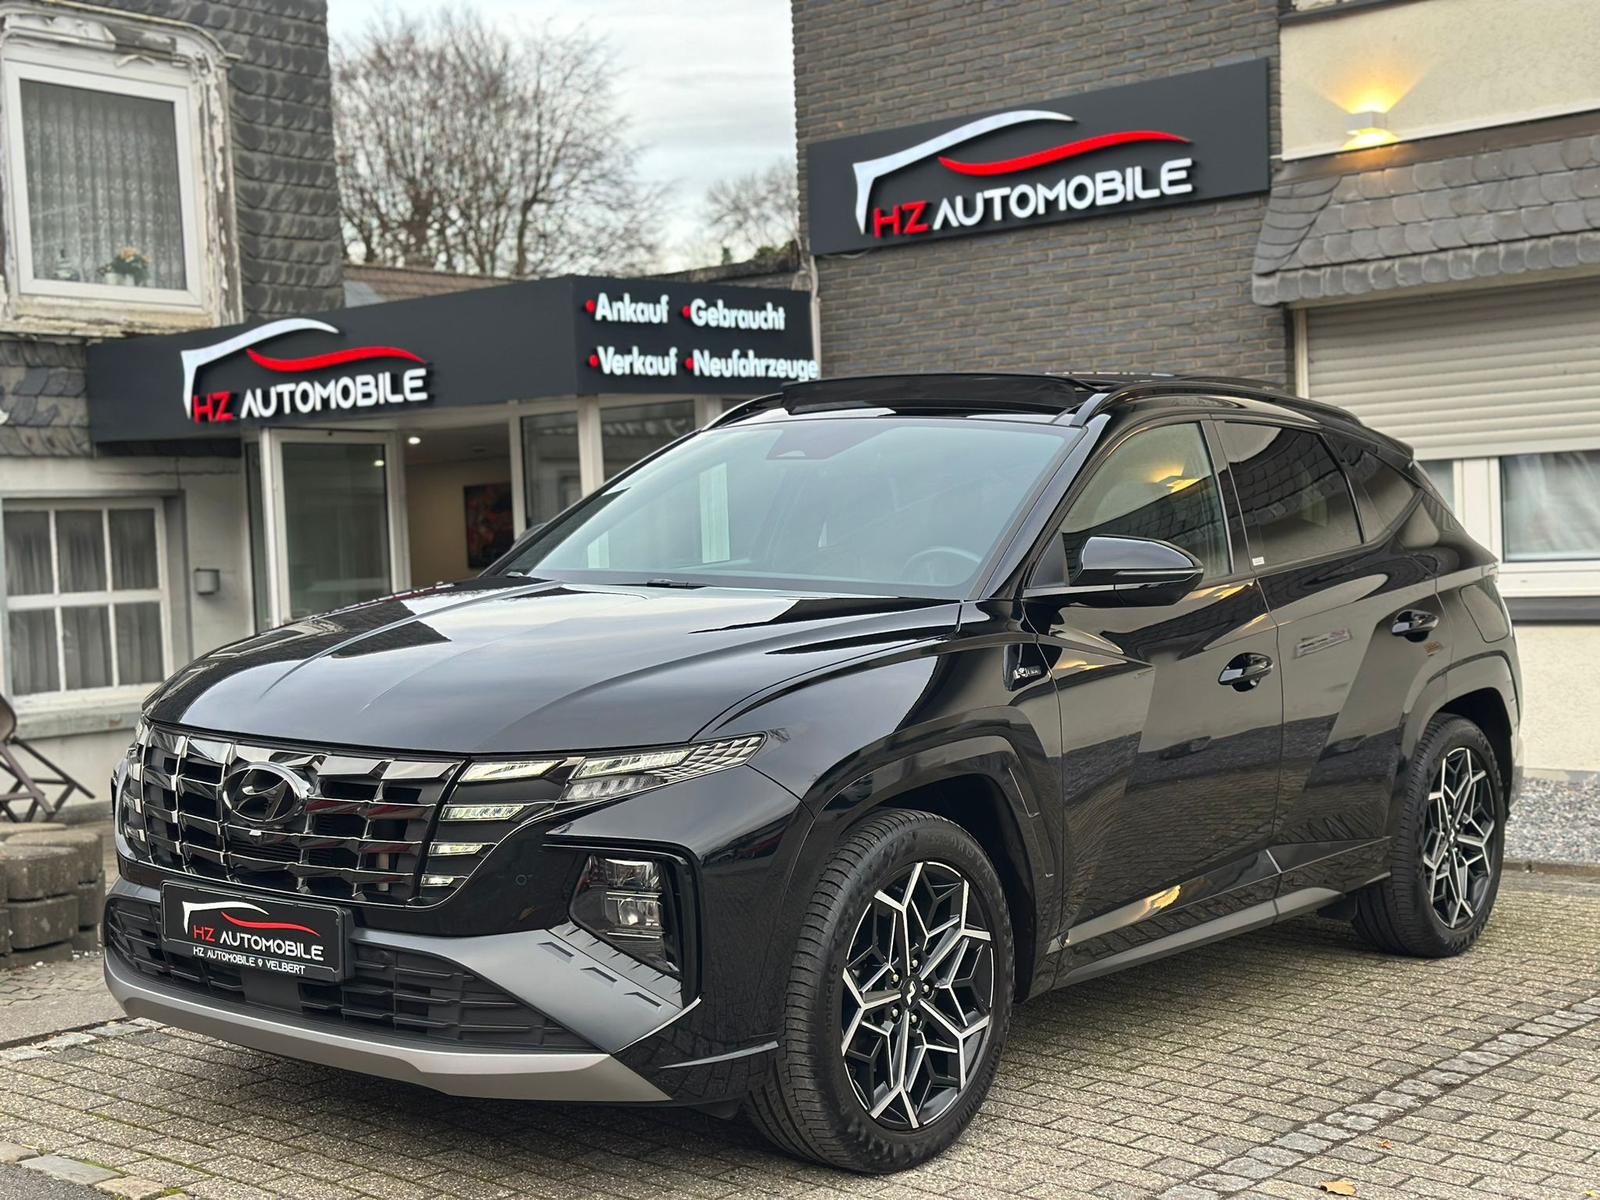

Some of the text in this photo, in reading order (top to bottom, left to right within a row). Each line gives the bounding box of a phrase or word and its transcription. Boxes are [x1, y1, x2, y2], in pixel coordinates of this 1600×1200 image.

[873, 157, 1193, 238] HZ AUTOMOBILE
[595, 293, 785, 330] Ankauf Gebraucht
[597, 346, 819, 382] Verkauf Neufahrzeuge
[192, 367, 427, 424] HZ AUTOMOBILE
[193, 925, 324, 961] HZ AUTOMOBILE
[193, 946, 306, 975] HZ AUTOMOBILE VELBERT
